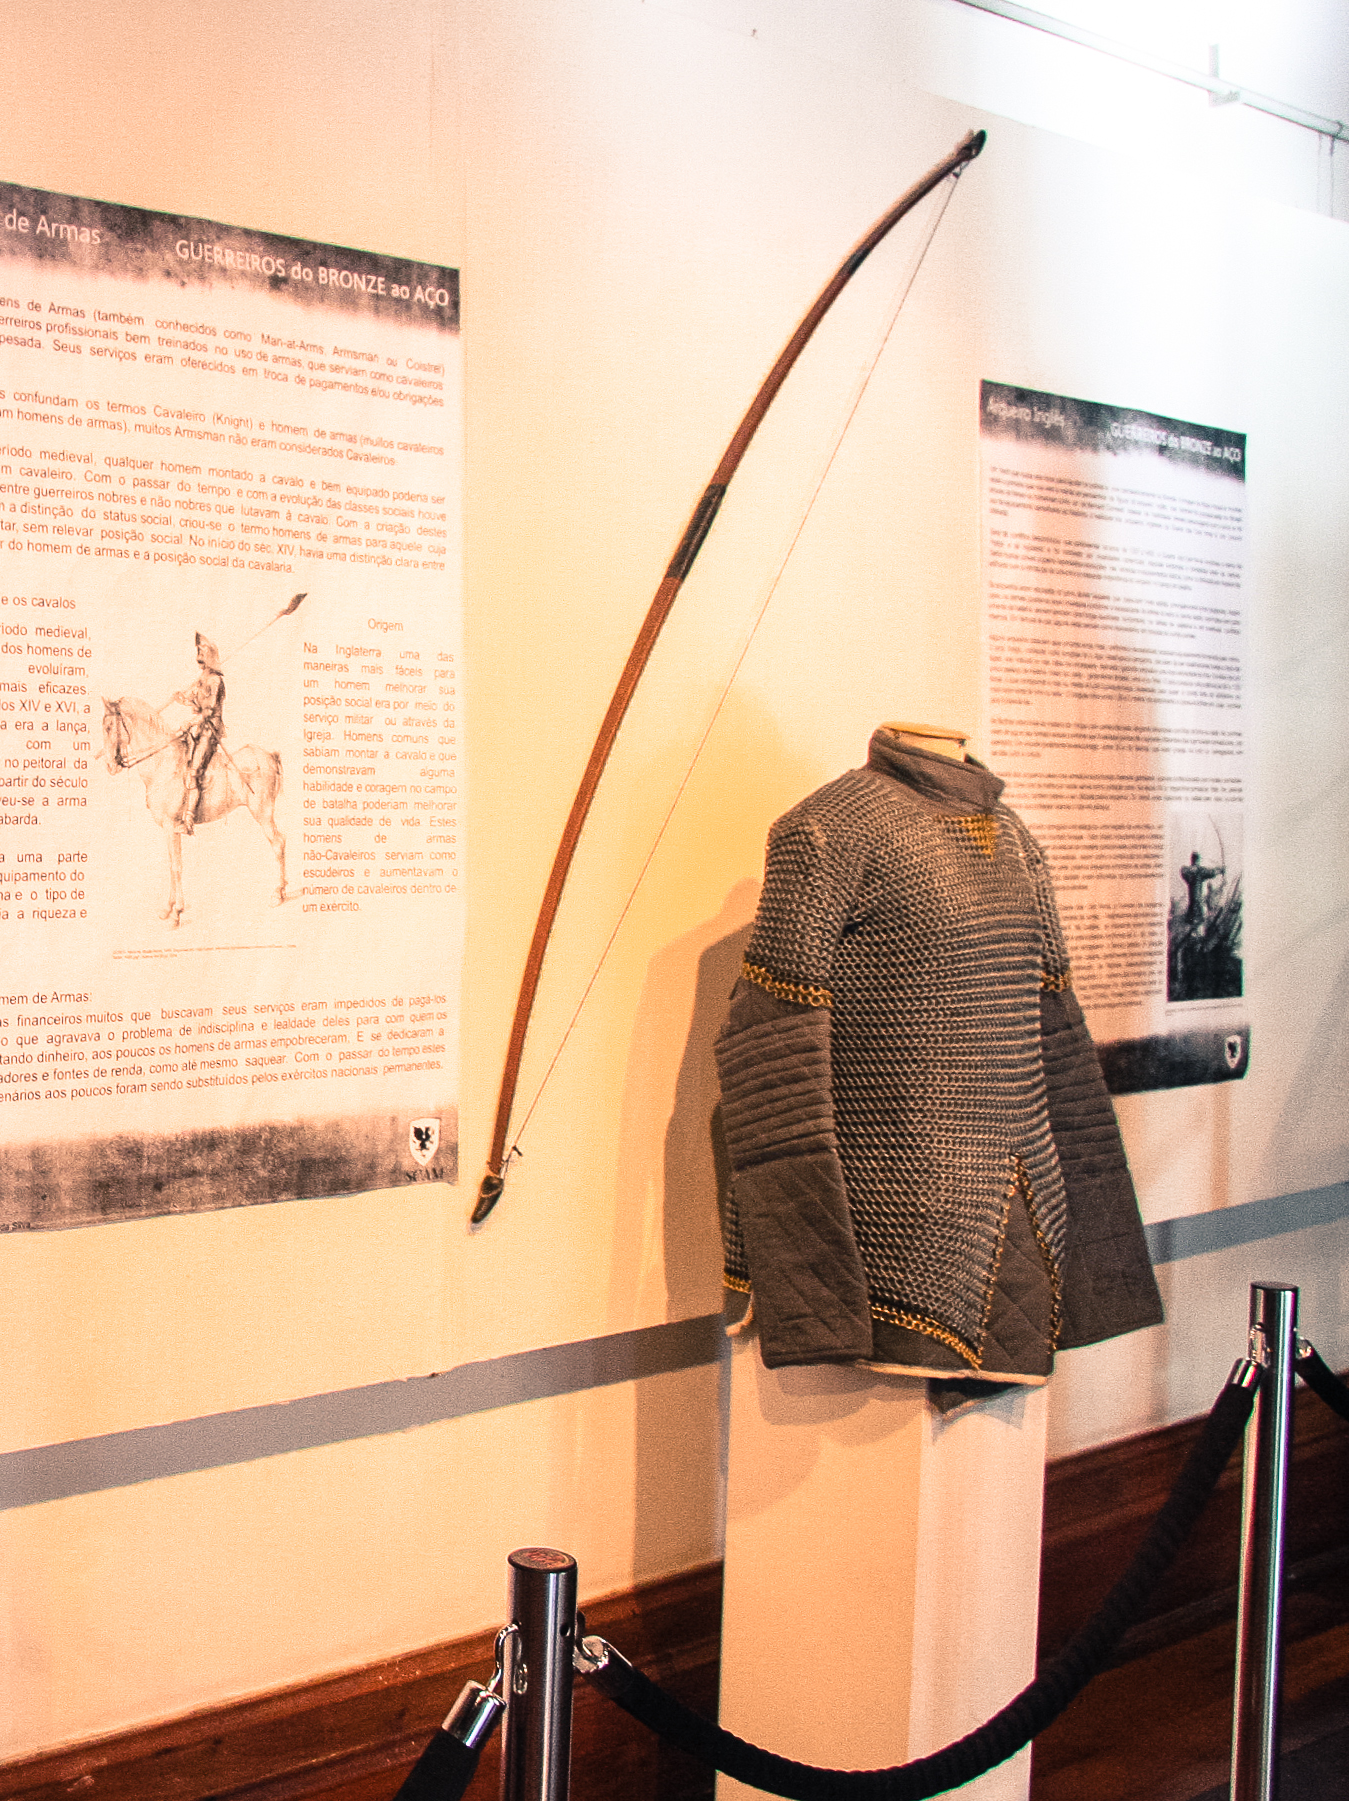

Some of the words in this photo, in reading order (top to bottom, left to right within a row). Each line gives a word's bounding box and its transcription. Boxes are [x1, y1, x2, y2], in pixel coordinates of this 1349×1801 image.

[5, 209, 29, 233] de
[36, 215, 101, 244] Armas
[175, 239, 286, 277] GUERREIROS
[291, 262, 313, 282] do
[318, 266, 386, 295] BRONZE
[391, 283, 410, 299] ao
[414, 285, 449, 308] AÇO
[26, 299, 42, 312] de
[48, 301, 86, 318] Armas
[154, 319, 217, 337] conhecidos
[222, 329, 252, 342] como
[386, 356, 397, 366] ou
[16, 407, 64, 424] homens
[66, 413, 82, 426] de
[86, 418, 130, 434] armas),
[134, 422, 171, 436] muitos
[228, 432, 248, 446] não
[250, 437, 276, 448] eram
[278, 441, 344, 458] considerados
[7, 537, 23, 551] do
[26, 539, 72, 554] homem
[75, 543, 91, 555] de
[94, 546, 130, 558] armas
[132, 549, 140, 559] e
[142, 550, 150, 560] a
[153, 551, 196, 566] posição
[198, 555, 229, 567] social
[231, 556, 245, 568] da
[0, 595, 8, 605] e
[12, 596, 27, 606] os
[30, 596, 76, 609] cavalos
[34, 624, 90, 640] medieval,
[367, 617, 404, 633] Origem
[0, 641, 23, 654] dos
[26, 642, 74, 657] homens
[76, 645, 92, 658] de
[303, 641, 318, 653] Na
[335, 644, 382, 658] Inglaterra
[399, 650, 420, 660] uma
[436, 651, 454, 662] das
[302, 661, 349, 672] maneiras
[360, 664, 384, 675] mais
[433, 669, 455, 680] para
[302, 679, 319, 687] um
[334, 678, 370, 690] homem
[438, 685, 456, 695] sua
[18, 699, 40, 711] XIV
[43, 702, 52, 712] e
[54, 700, 79, 714] XVI,
[82, 704, 90, 713] a
[14, 720, 34, 730] era
[40, 721, 48, 731] a
[56, 719, 90, 735] lança,
[25, 739, 51, 750] com
[72, 741, 90, 751] um
[4, 758, 19, 768] no
[22, 756, 66, 771] peitoral
[73, 757, 88, 769] da
[302, 762, 376, 775] demonstravam
[31, 774, 46, 787] do
[49, 775, 88, 788] século
[41, 796, 49, 806] a
[56, 796, 87, 806] arma
[16, 852, 42, 863] uma
[57, 850, 88, 865] parte
[69, 868, 84, 881] do
[14, 890, 22, 900] e
[30, 890, 38, 900] o
[44, 888, 67, 903] tipo
[70, 887, 84, 899] de
[16, 909, 24, 919] a
[32, 908, 76, 921] riqueza
[79, 908, 87, 918] e
[31, 992, 48, 1004] de
[50, 991, 92, 1003] Armas:
[44, 1089, 67, 1099] aos
[70, 1085, 112, 1100] poucos
[115, 1082, 147, 1094] foram
[150, 1078, 183, 1092] sendo
[250, 1071, 278, 1086] pelos
[330, 1065, 378, 1077] nacionais
